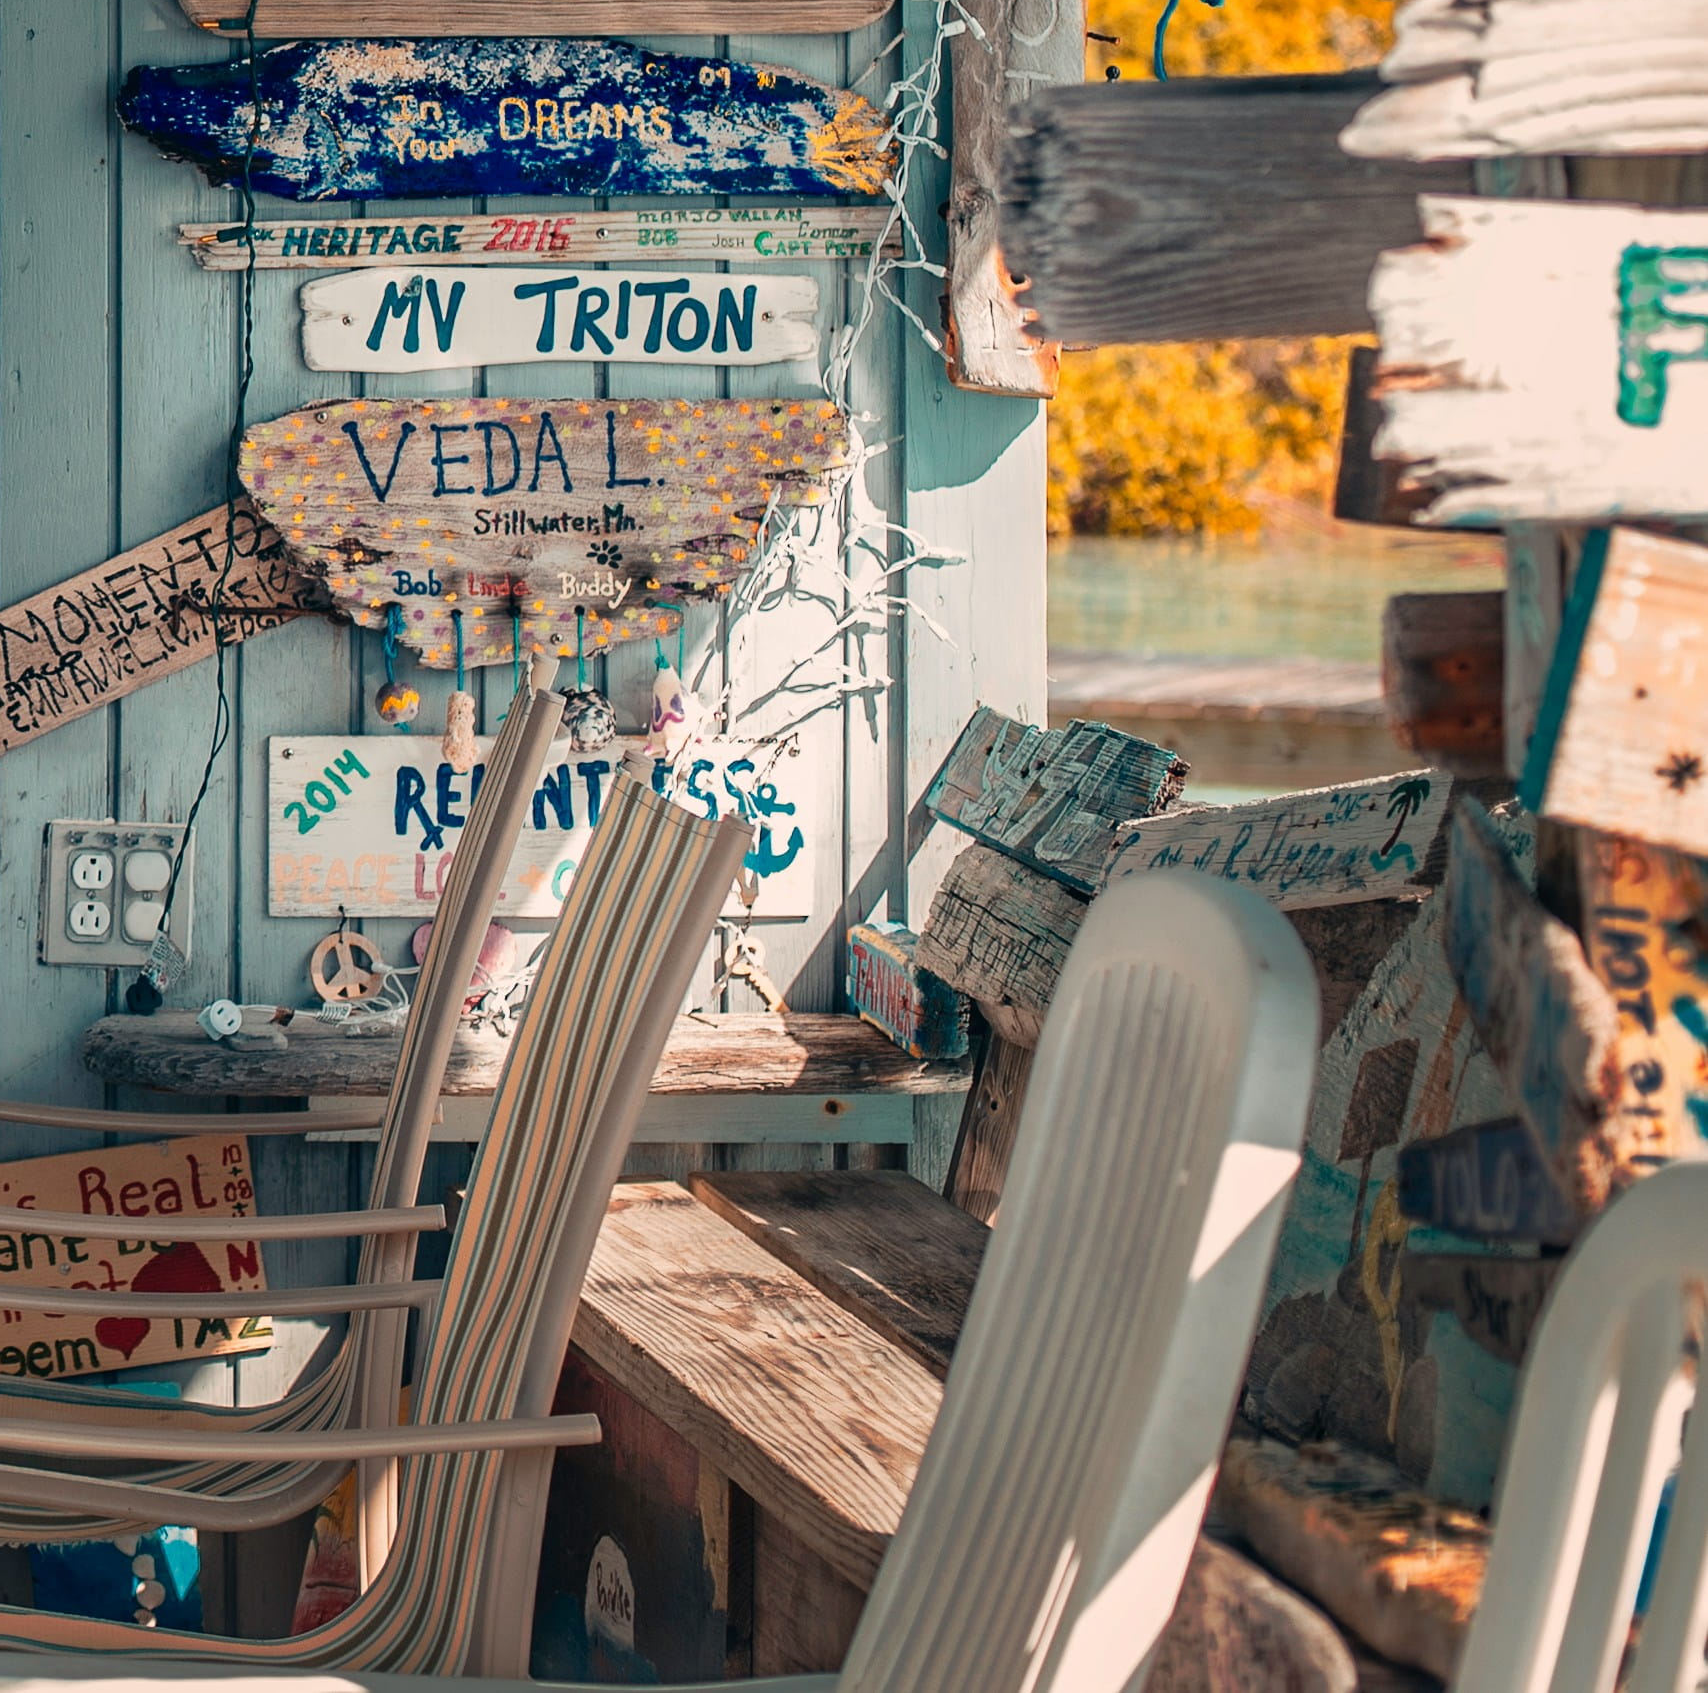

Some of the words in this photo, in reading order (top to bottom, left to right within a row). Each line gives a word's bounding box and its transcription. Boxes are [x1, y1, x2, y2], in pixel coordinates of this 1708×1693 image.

[497, 96, 675, 144] DREAMS
[284, 224, 465, 256] HERITAGE
[366, 279, 467, 353] MV
[513, 276, 759, 355] TRITON
[342, 409, 575, 503] VEDA
[392, 567, 442, 598] Bob
[559, 571, 632, 607] Buddy
[282, 747, 373, 835] 2014
[274, 853, 402, 903] PEACE
